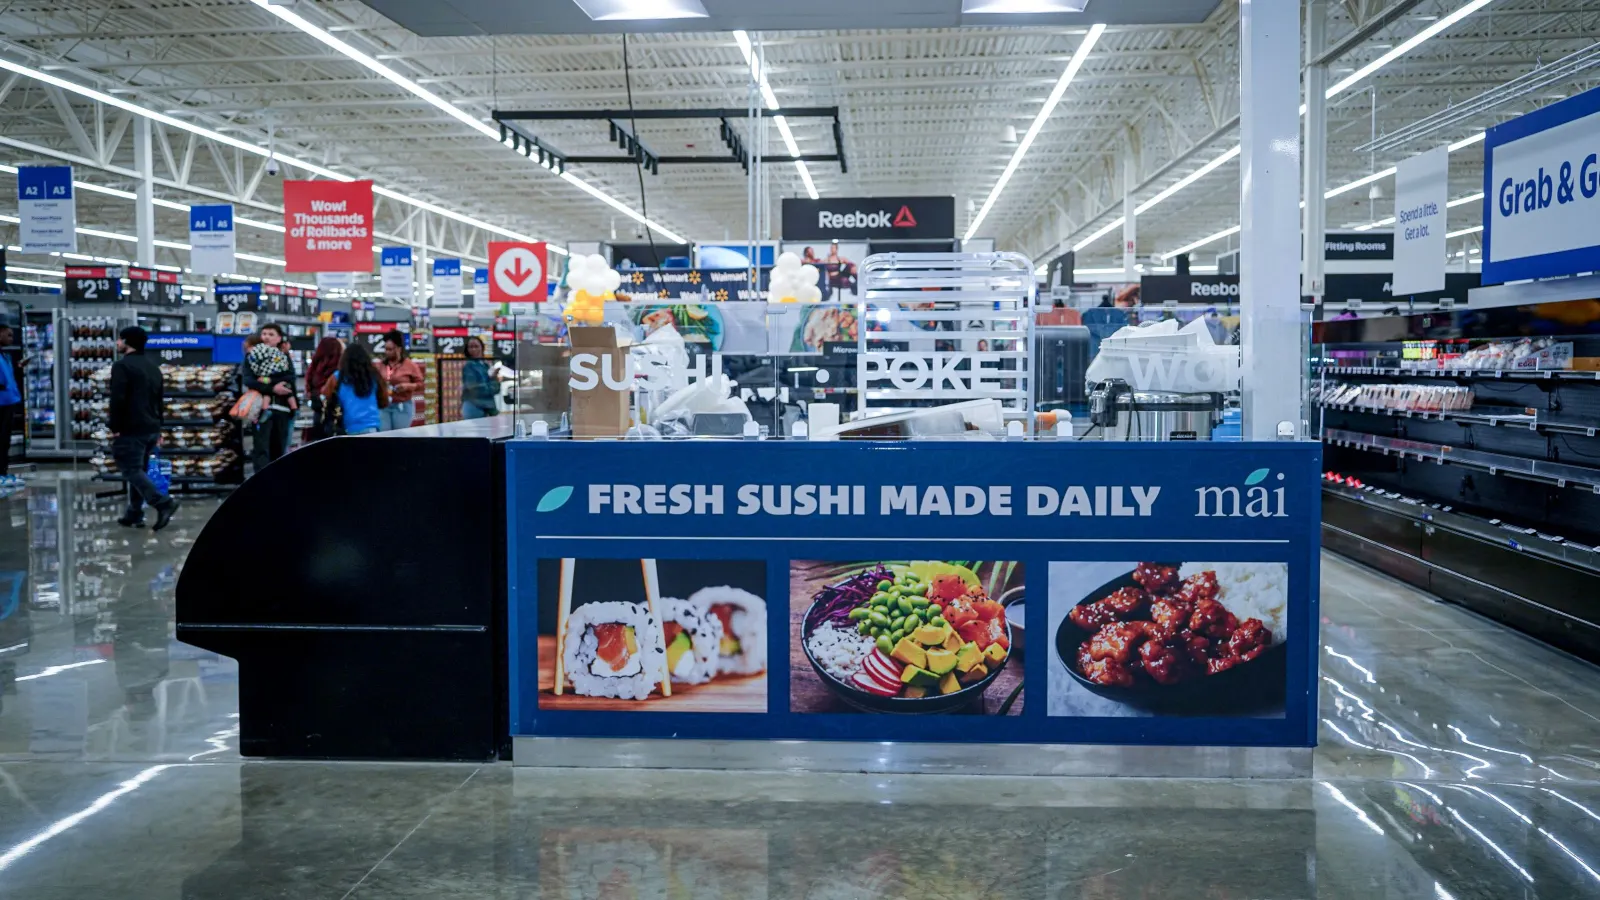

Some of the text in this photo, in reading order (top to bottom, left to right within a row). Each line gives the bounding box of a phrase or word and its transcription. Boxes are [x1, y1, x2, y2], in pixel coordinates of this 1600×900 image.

[26, 186, 38, 195] A2
[1499, 154, 1600, 217] Grab & G
[311, 200, 346, 212] Wow!
[294, 213, 364, 224] Thousands
[818, 210, 892, 228] Reebok
[1400, 206, 1418, 224] Spend
[290, 226, 367, 238] of Rollbacks
[1404, 227, 1415, 240] Get
[1420, 224, 1430, 237] lot.
[306, 239, 352, 250] & more
[1324, 242, 1386, 252] Fitting Rooms
[710, 272, 747, 282] Walmart
[1191, 282, 1240, 296] Reebo
[568, 353, 722, 391] SUSHI
[857, 354, 1000, 390] POKE
[588, 484, 1161, 516] FRESH SUSHI MADE DAILY
